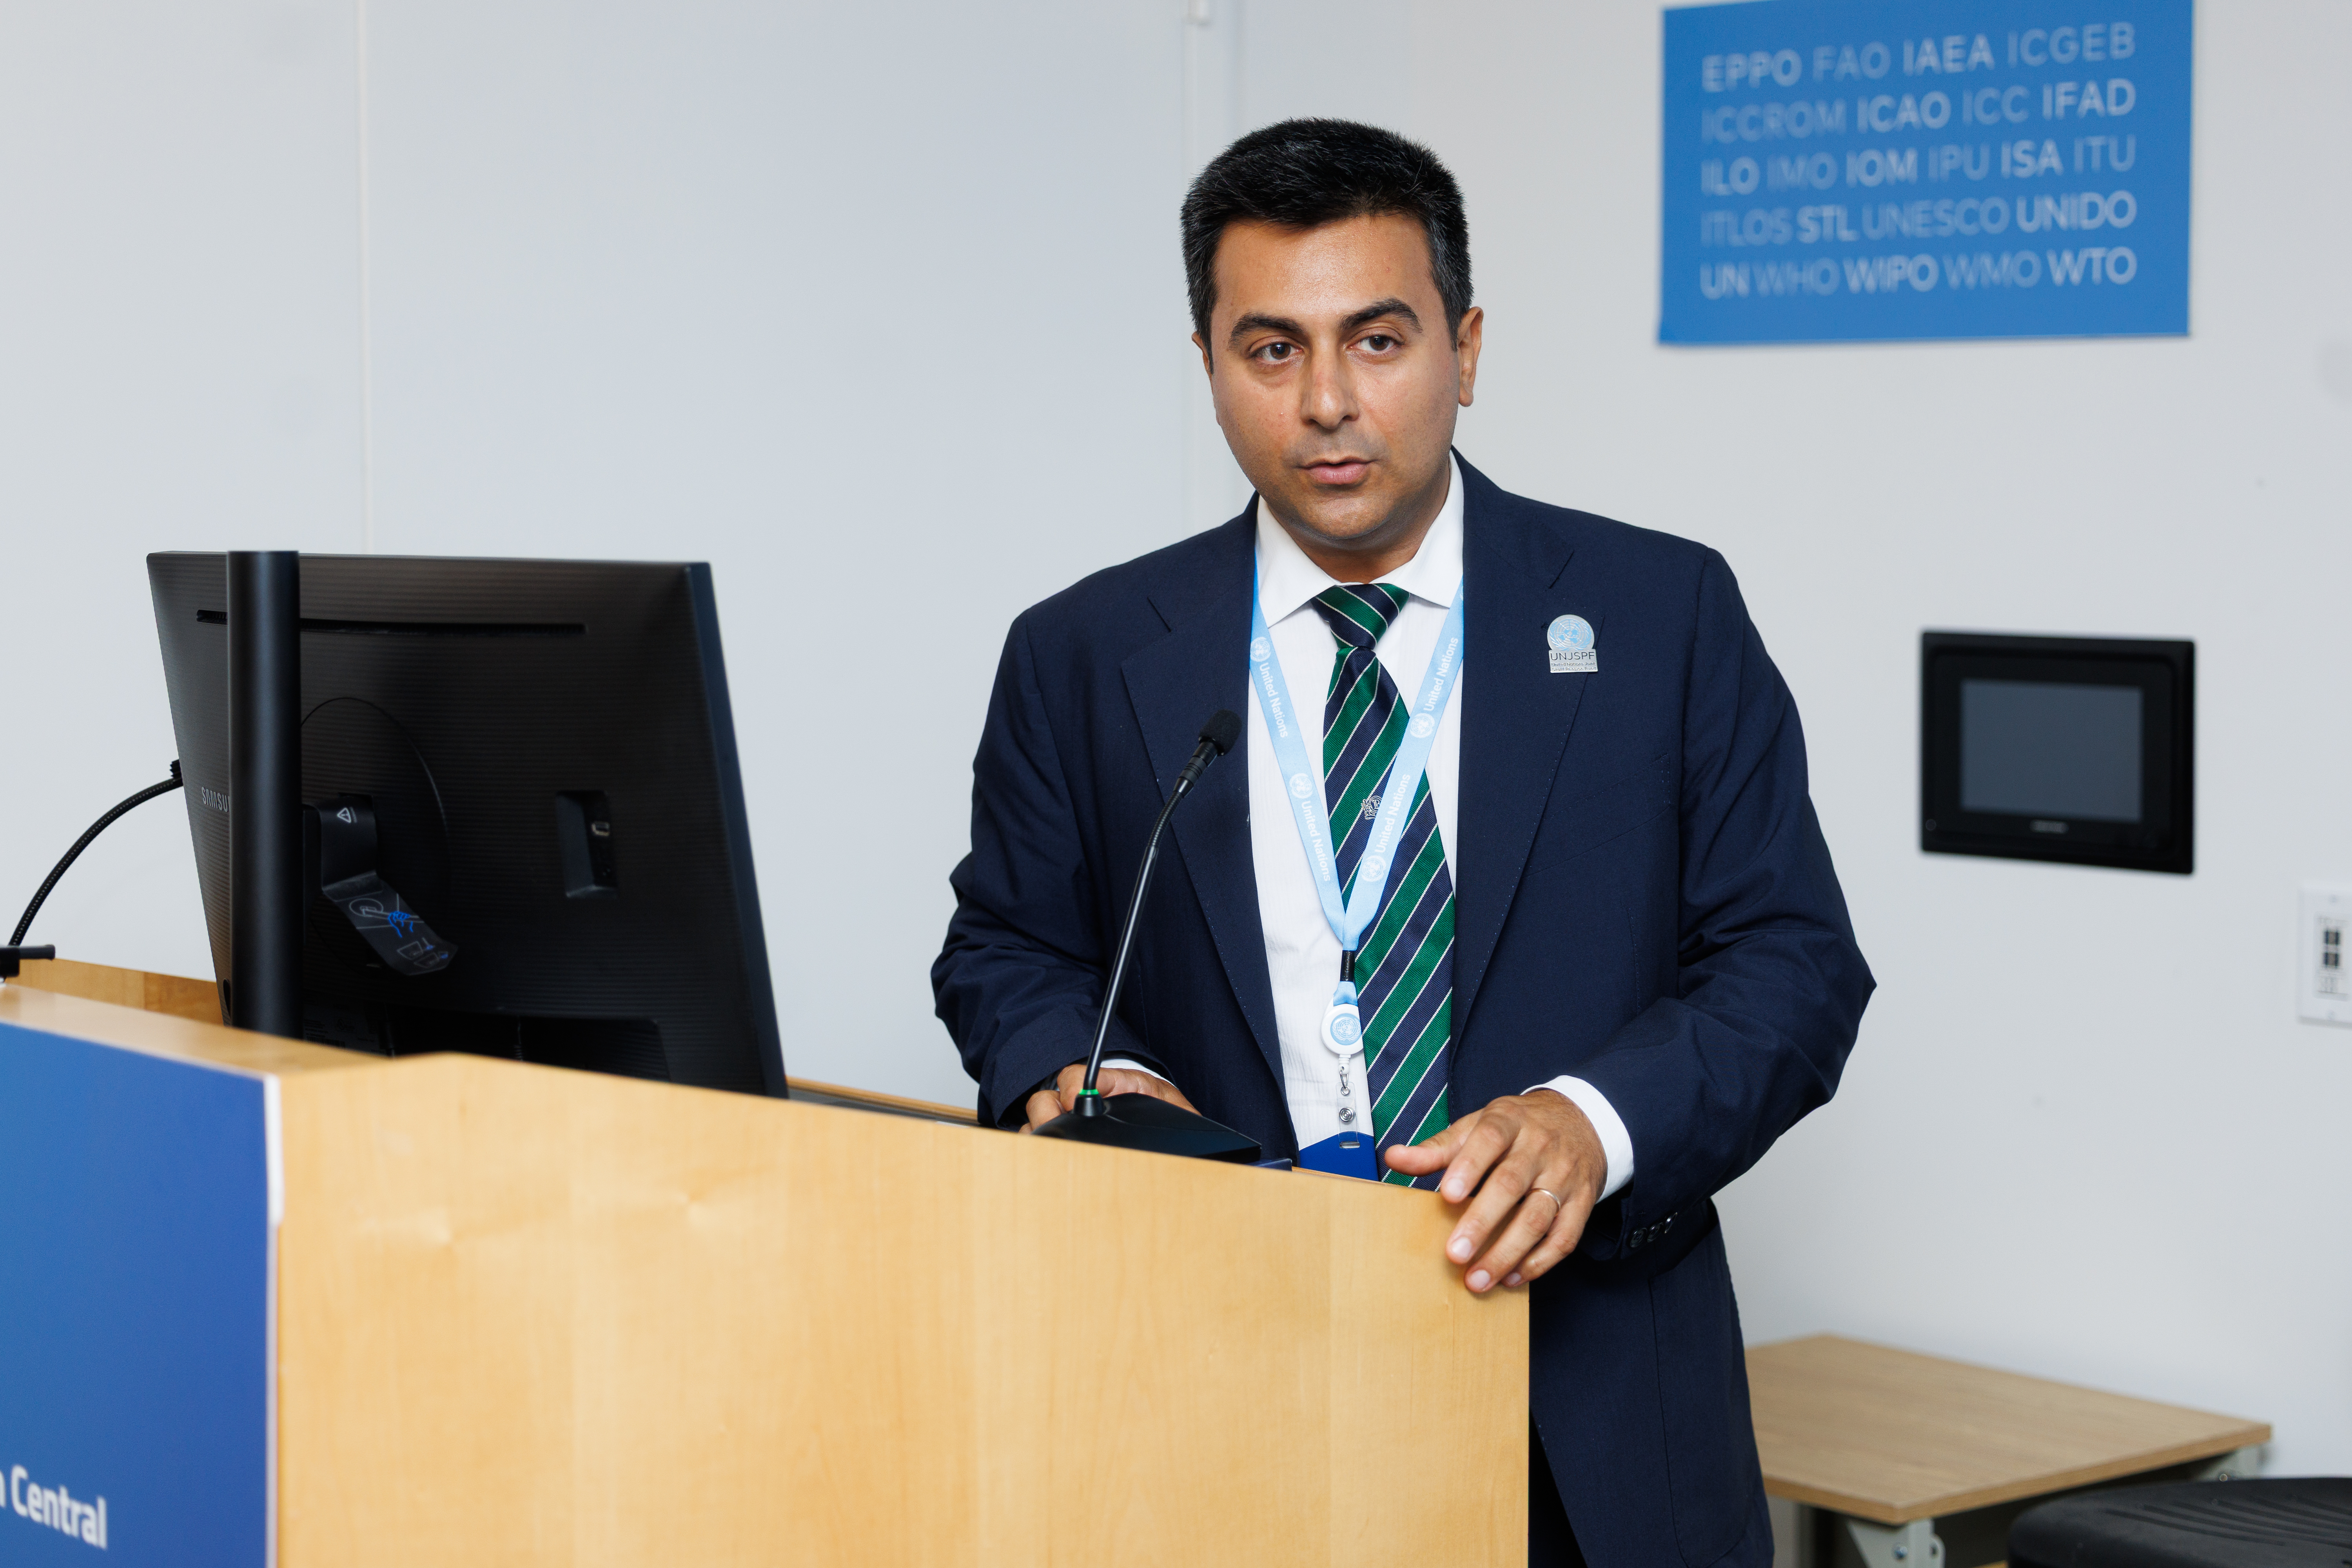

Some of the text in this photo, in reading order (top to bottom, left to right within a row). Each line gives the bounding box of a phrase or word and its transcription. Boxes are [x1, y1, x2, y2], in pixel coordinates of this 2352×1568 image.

[1702, 22, 2135, 92] EPPO FAO IAEA ICGEB
[1702, 78, 2136, 144] ICCROM ICAO ICC IFAD
[1701, 134, 2136, 195] ILO IMO IOM IPU ISA ITU
[1701, 190, 2137, 247] ITLOS STL UNESCO UNIDO
[1700, 247, 2137, 299] UN WHO WIPO WMO WTO
[1423, 637, 1459, 711] United Nations
[1550, 652, 1595, 661] UNJSPF
[1259, 662, 1288, 738] United Nations
[201, 786, 230, 812] SAMSU
[1374, 774, 1410, 853] United Nations
[1301, 800, 1330, 882] United Nations
[11, 1465, 107, 1550] Central
